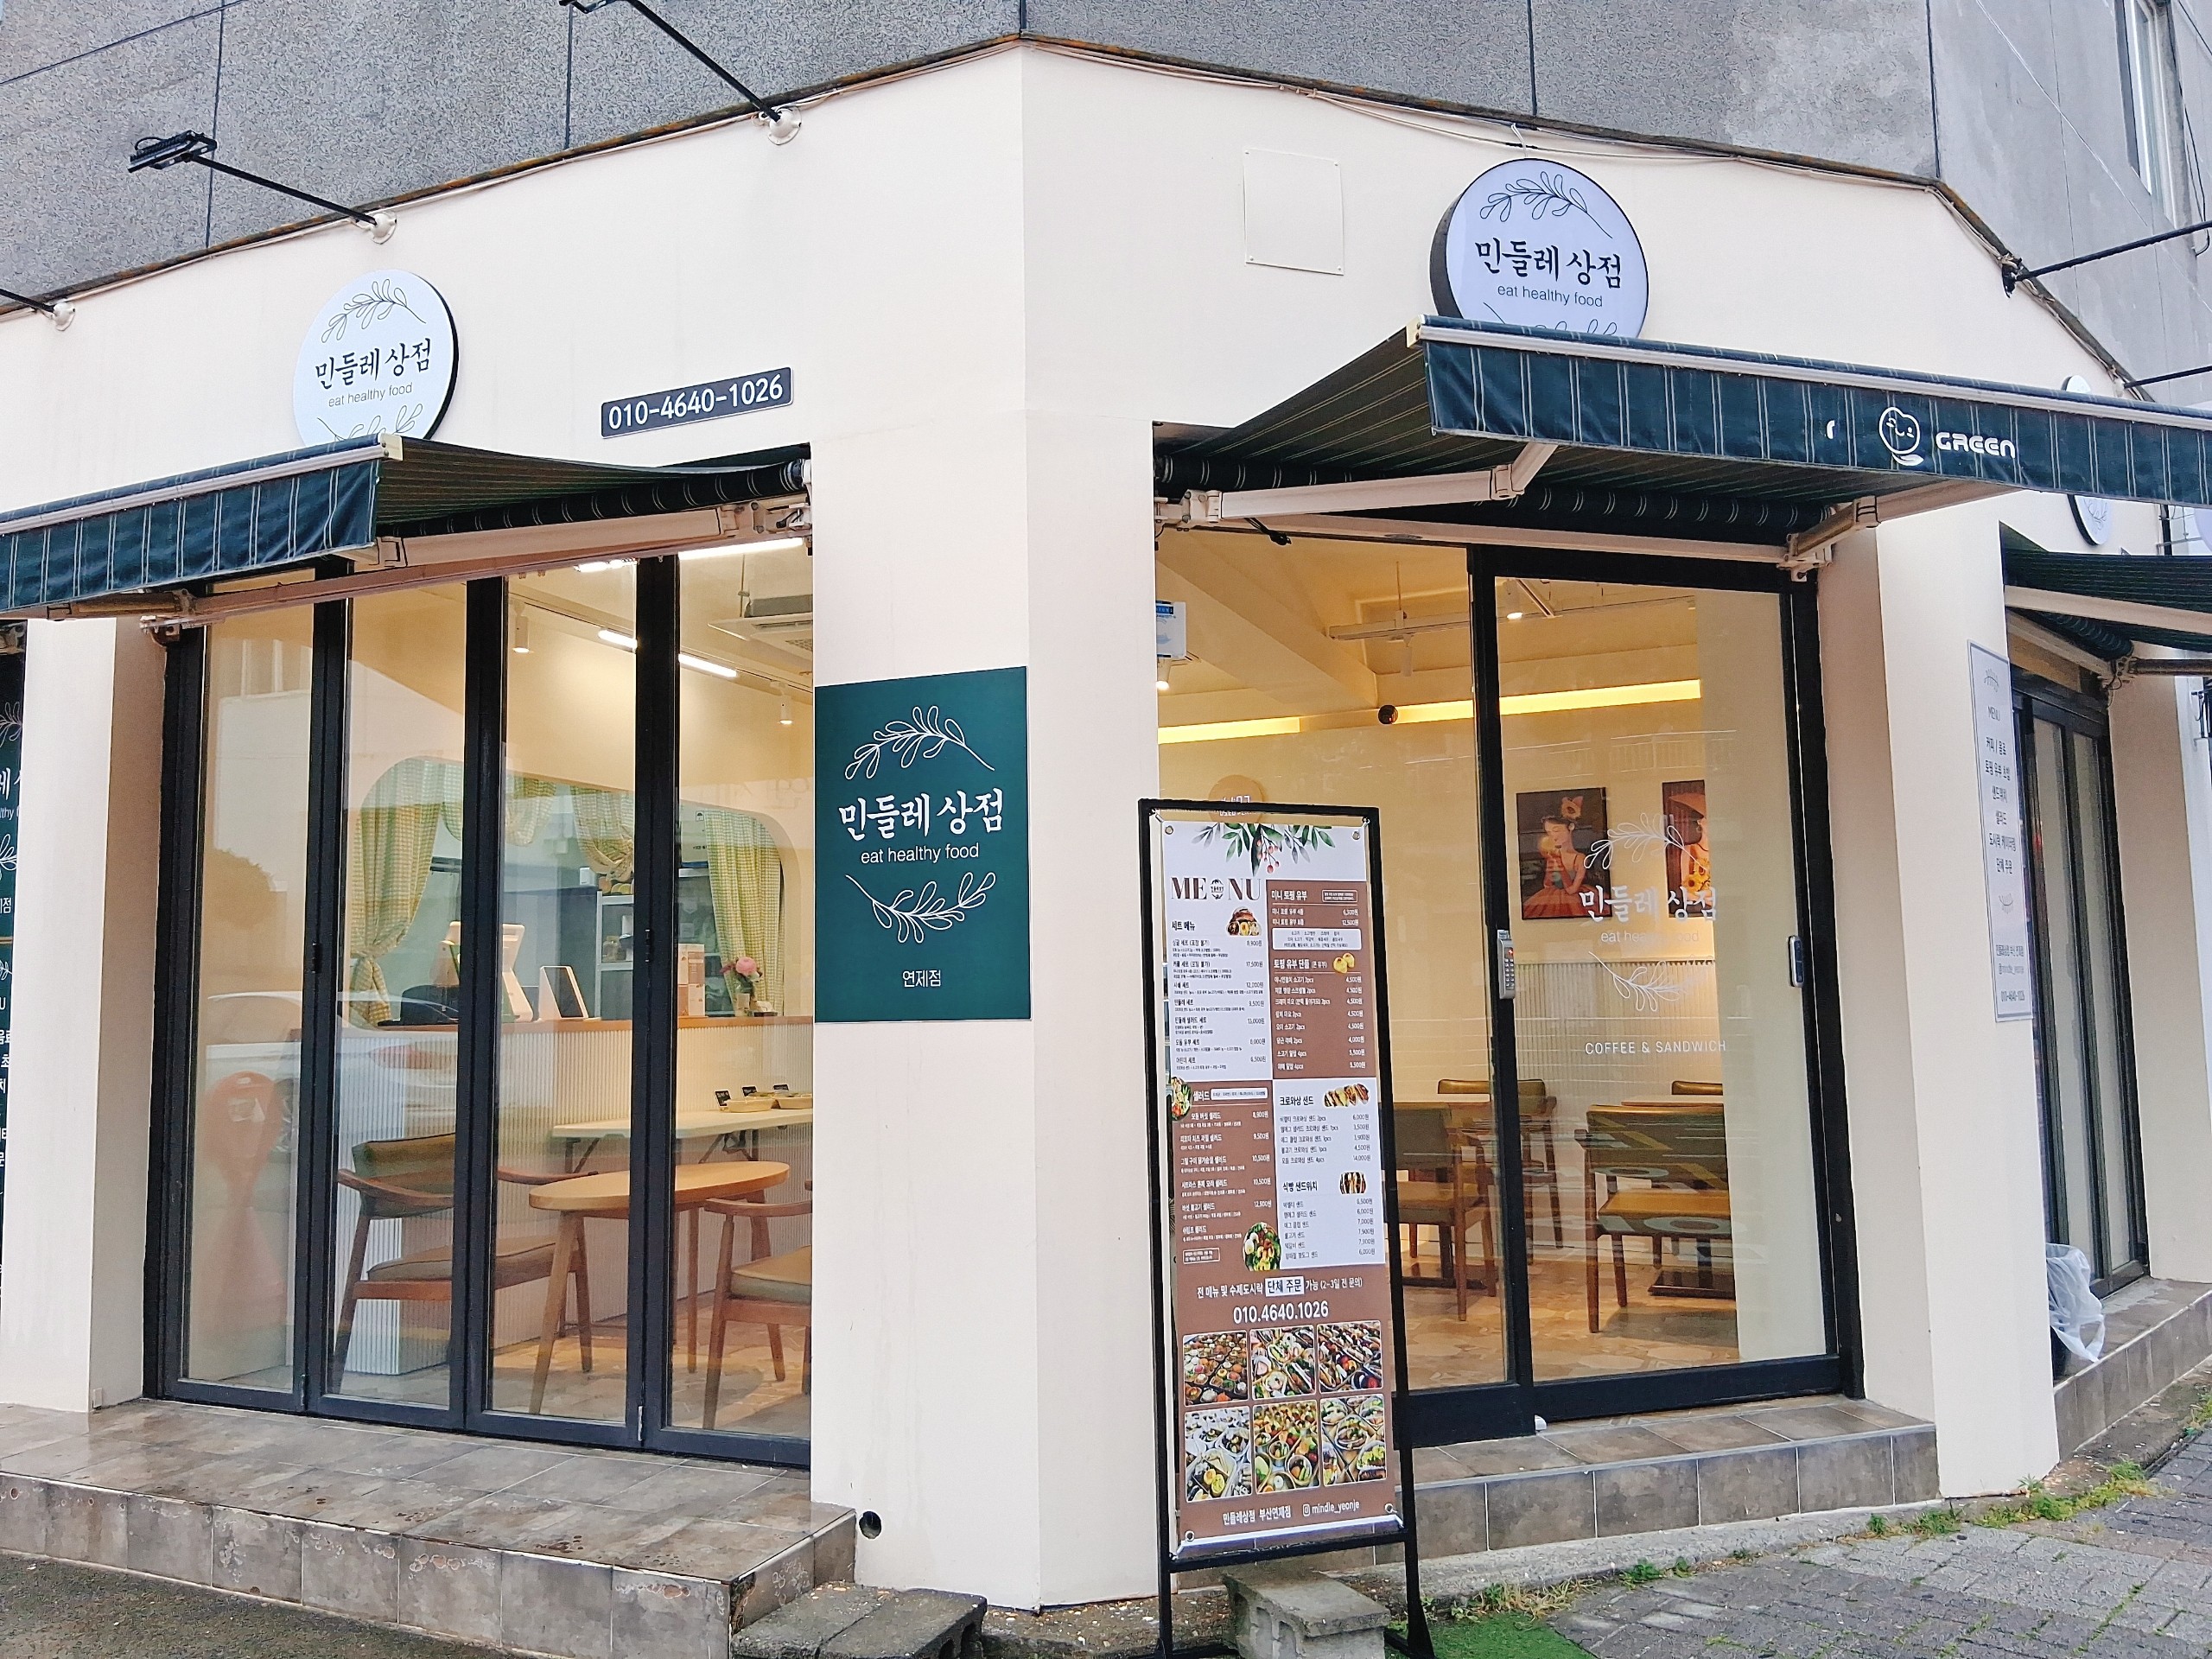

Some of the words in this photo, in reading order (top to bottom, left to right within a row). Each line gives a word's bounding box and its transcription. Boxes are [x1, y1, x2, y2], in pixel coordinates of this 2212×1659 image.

[1475, 237, 1559, 282] 민들레
[1566, 249, 1621, 289] 상점
[1497, 285, 1518, 297] eat
[1522, 286, 1570, 306] healthy
[1574, 291, 1603, 307] food
[315, 347, 379, 390] 민들레
[385, 338, 430, 377] 상점
[328, 396, 345, 407] eat
[347, 388, 385, 404] healthy
[389, 382, 413, 397] food
[608, 373, 783, 430] 010-4640-1026
[1936, 432, 2016, 459] GREEN
[838, 793, 930, 842] 민들레
[936, 787, 1003, 836] 상점
[861, 849, 883, 864] eat
[888, 845, 941, 865] healthy
[944, 842, 979, 859] food
[1271, 890, 1282, 900] 미니
[1283, 891, 1294, 900] 토핑
[1296, 891, 1307, 900] 유부
[1579, 885, 1659, 923] 민들레
[1668, 886, 1717, 922] 상점
[1172, 921, 1183, 931] 세트
[1184, 921, 1196, 931] 메뉴
[1600, 931, 1620, 944] eat
[1274, 958, 1285, 969] 토핑
[1286, 958, 1298, 969] 유부
[1298, 958, 1310, 969] 단품
[902, 969, 942, 988] 연제점
[1585, 1042, 1636, 1054] COFFEE
[1642, 1042, 1650, 1052] &
[1656, 1039, 1726, 1053] SANDWICH
[1193, 1090, 1210, 1102] 샐러드
[1280, 1096, 1301, 1106] 크로와상
[1282, 1181, 1294, 1192] 식빵
[1197, 1287, 1204, 1299] 전
[1205, 1286, 1219, 1298] 메뉴
[1220, 1285, 1228, 1297] 및
[1230, 1282, 1263, 1296] 수제도시락
[1268, 1281, 1284, 1294] 단체
[1286, 1279, 1301, 1293] 주문
[1306, 1279, 1319, 1291] 가능
[1320, 1278, 1340, 1290] (2-3일
[1341, 1277, 1348, 1288] 전
[1349, 1276, 1363, 1287] 문의)
[1233, 1300, 1329, 1325] 010.4640.1026
[1223, 1509, 1255, 1526] 민들레상점
